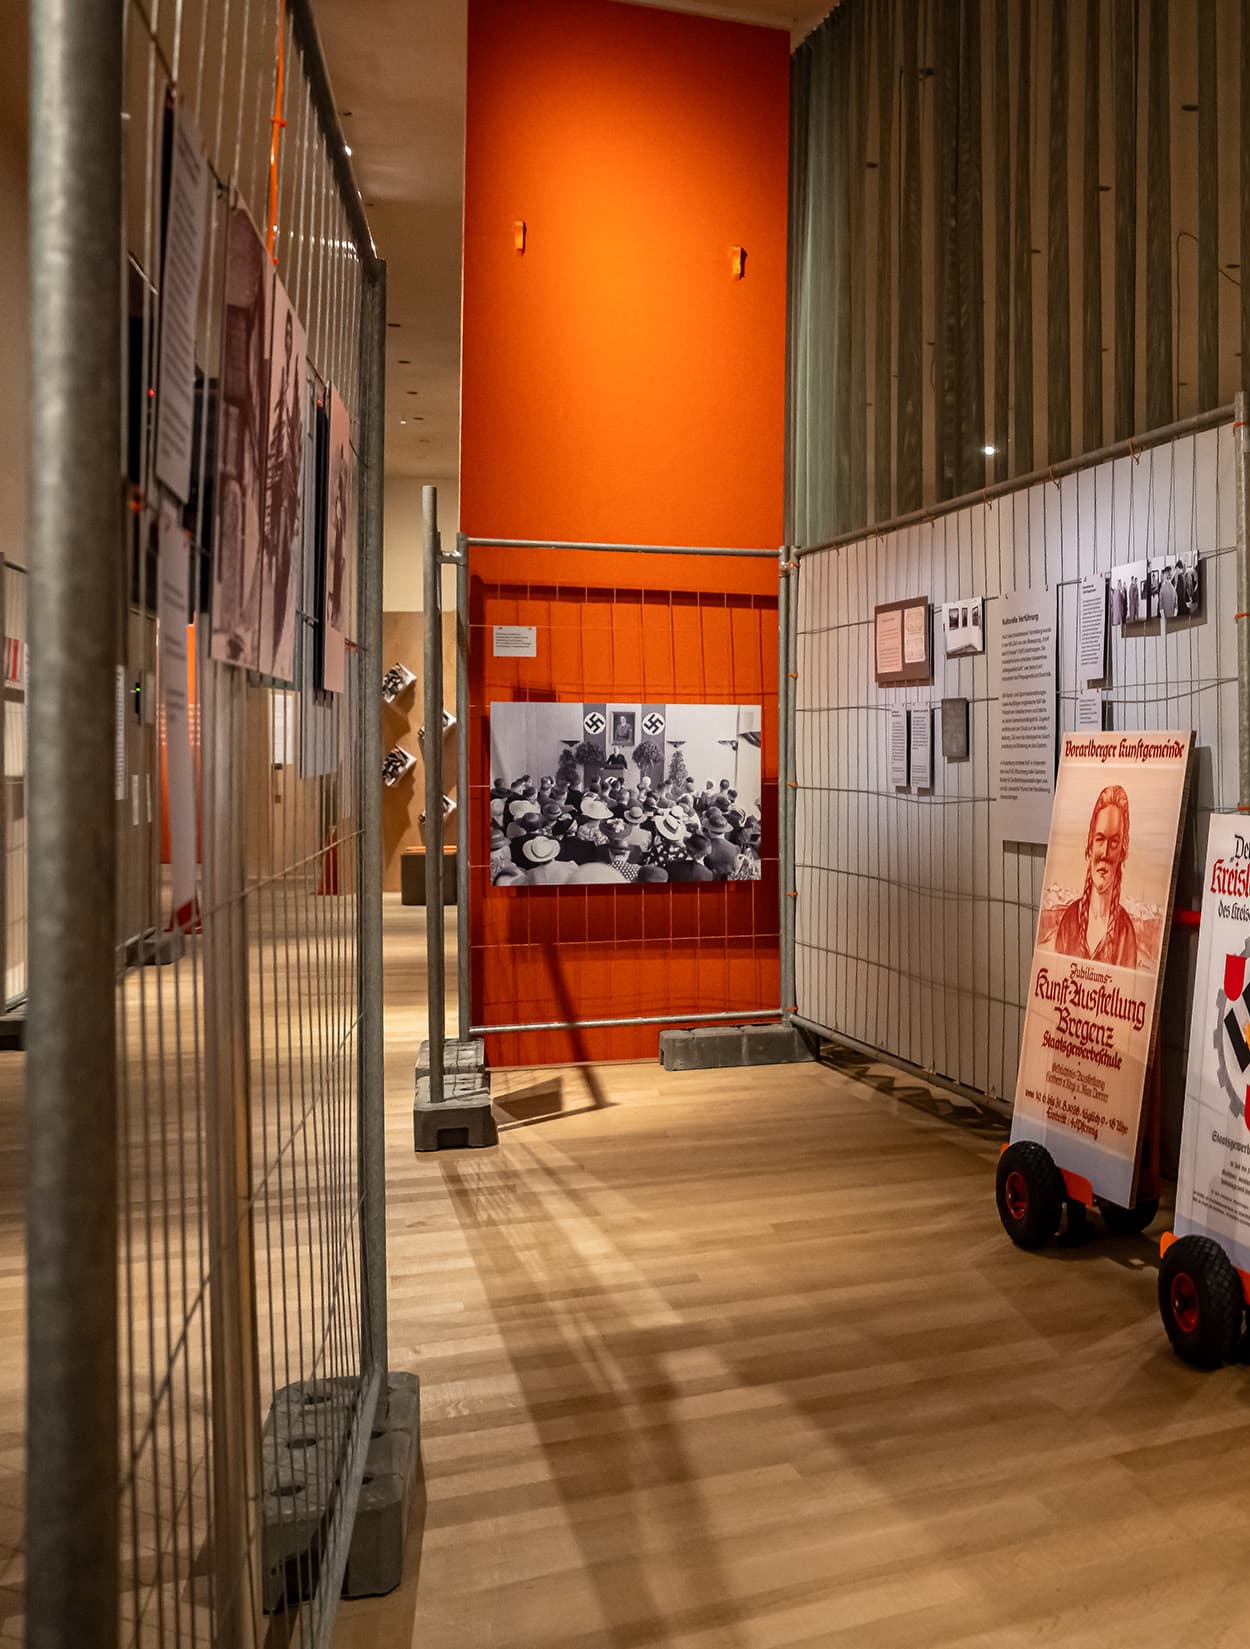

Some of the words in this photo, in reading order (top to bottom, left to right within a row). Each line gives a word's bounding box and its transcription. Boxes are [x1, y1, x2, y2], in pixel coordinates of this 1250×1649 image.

[1065, 739, 1118, 763] Vorarlberger
[1218, 899, 1231, 919] des
[1054, 1006, 1115, 1049] Bregenz
[1041, 1030, 1123, 1070] Staatsgewerbeschule
